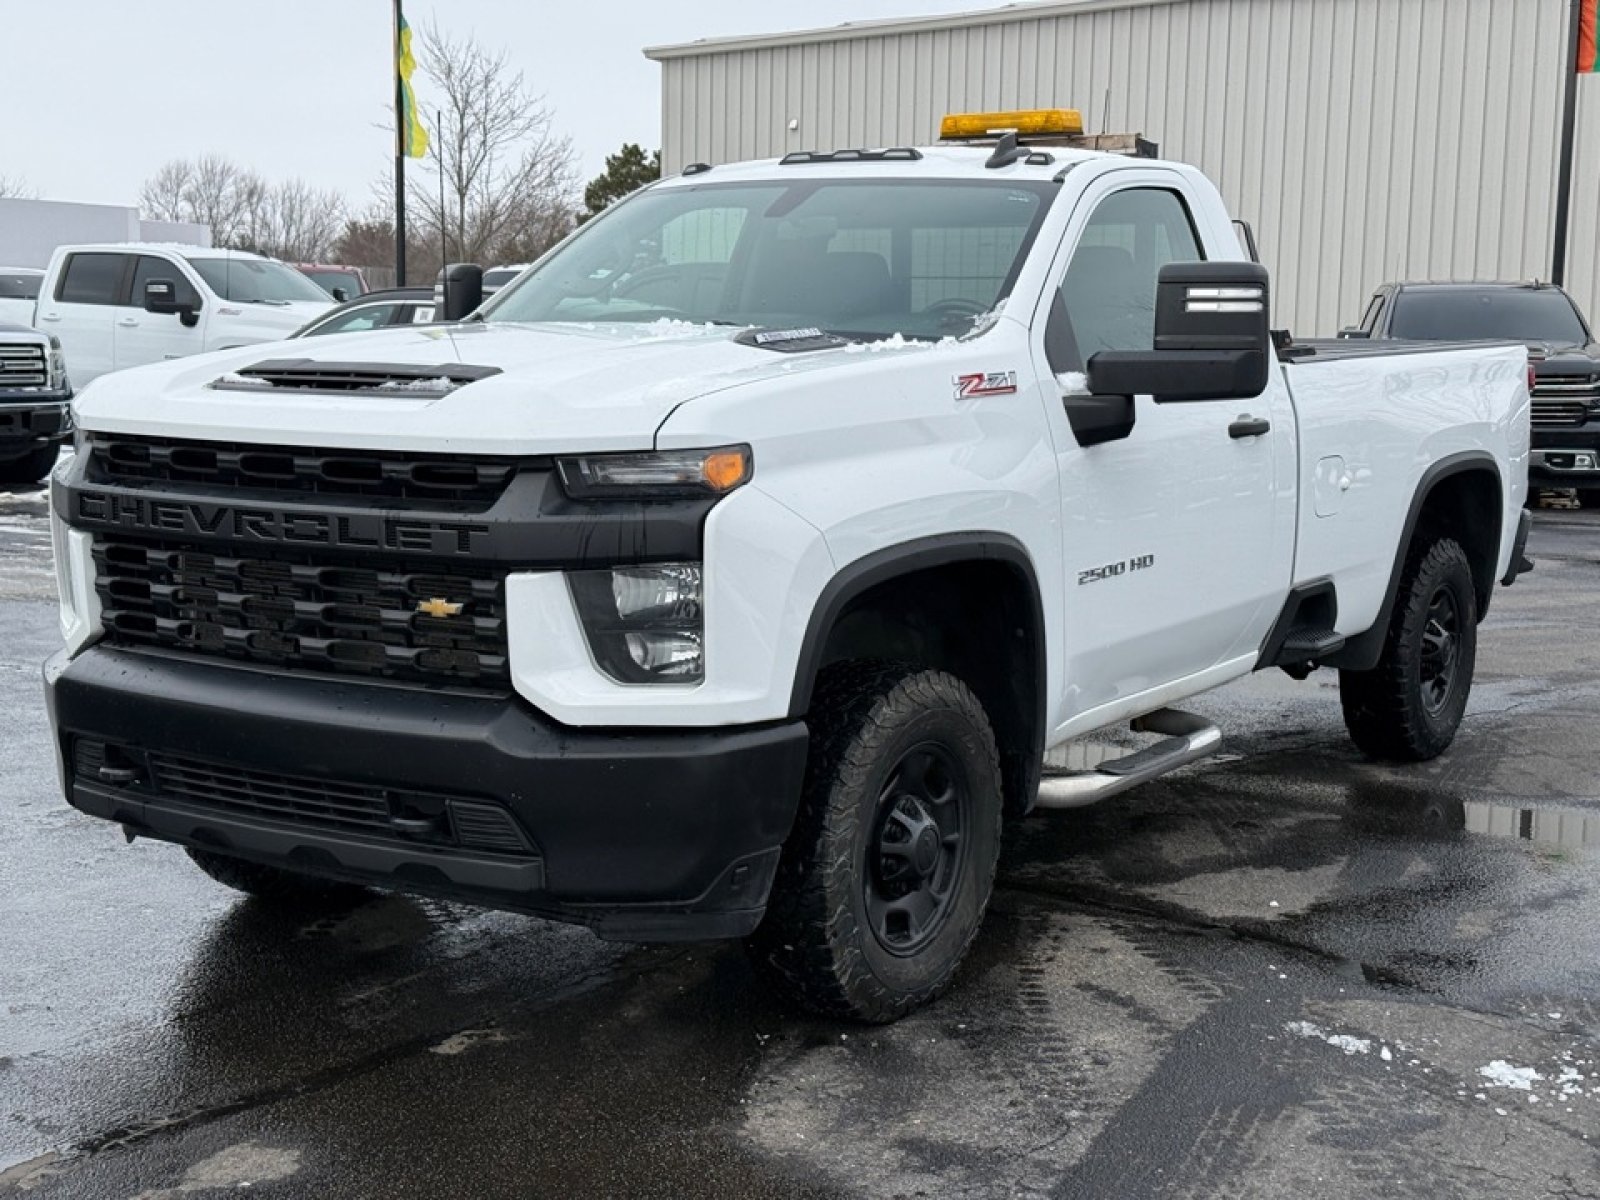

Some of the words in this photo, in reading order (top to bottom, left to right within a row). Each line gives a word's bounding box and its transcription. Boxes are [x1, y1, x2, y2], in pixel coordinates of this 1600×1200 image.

[952, 371, 1017, 400] Z71
[79, 491, 489, 553] CHEVROLET
[1078, 561, 1126, 585] 2500
[1129, 554, 1154, 572] HD
